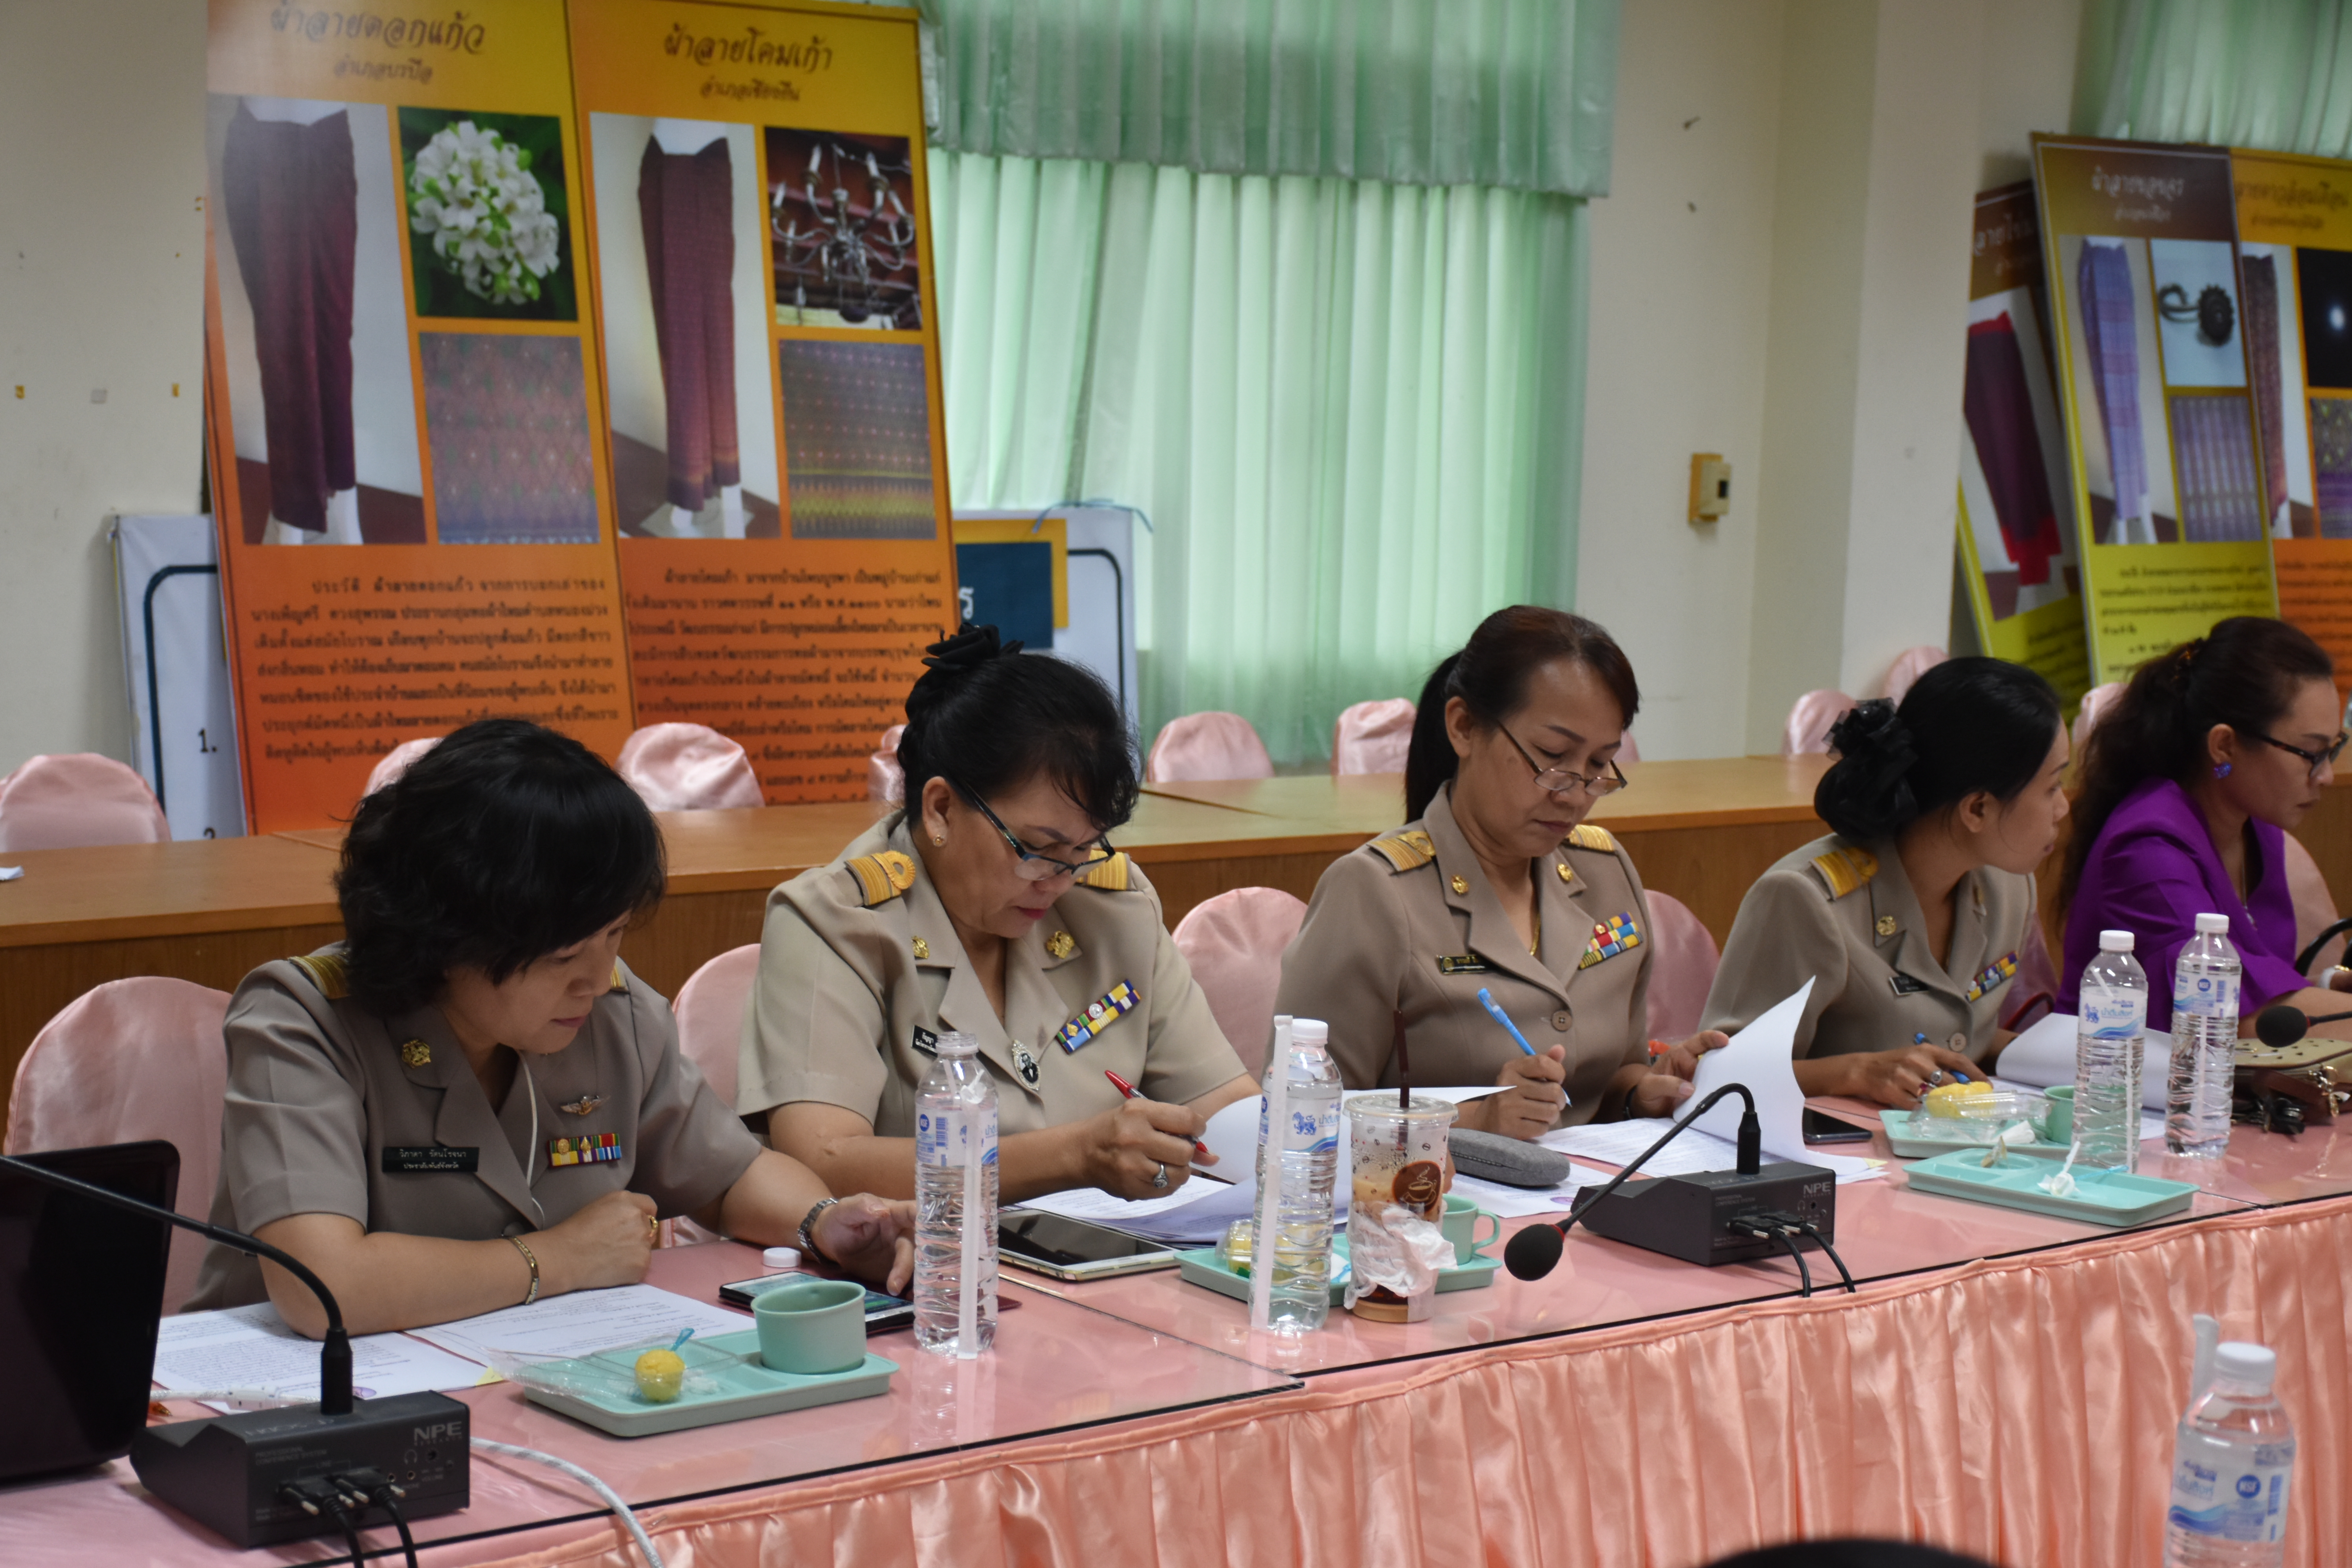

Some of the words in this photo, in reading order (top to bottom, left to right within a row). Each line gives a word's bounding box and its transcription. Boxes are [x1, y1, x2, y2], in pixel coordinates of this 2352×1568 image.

[198, 728, 218, 753] 1.
[1803, 1181, 1831, 1195] NPE
[414, 1421, 462, 1441] NPE
